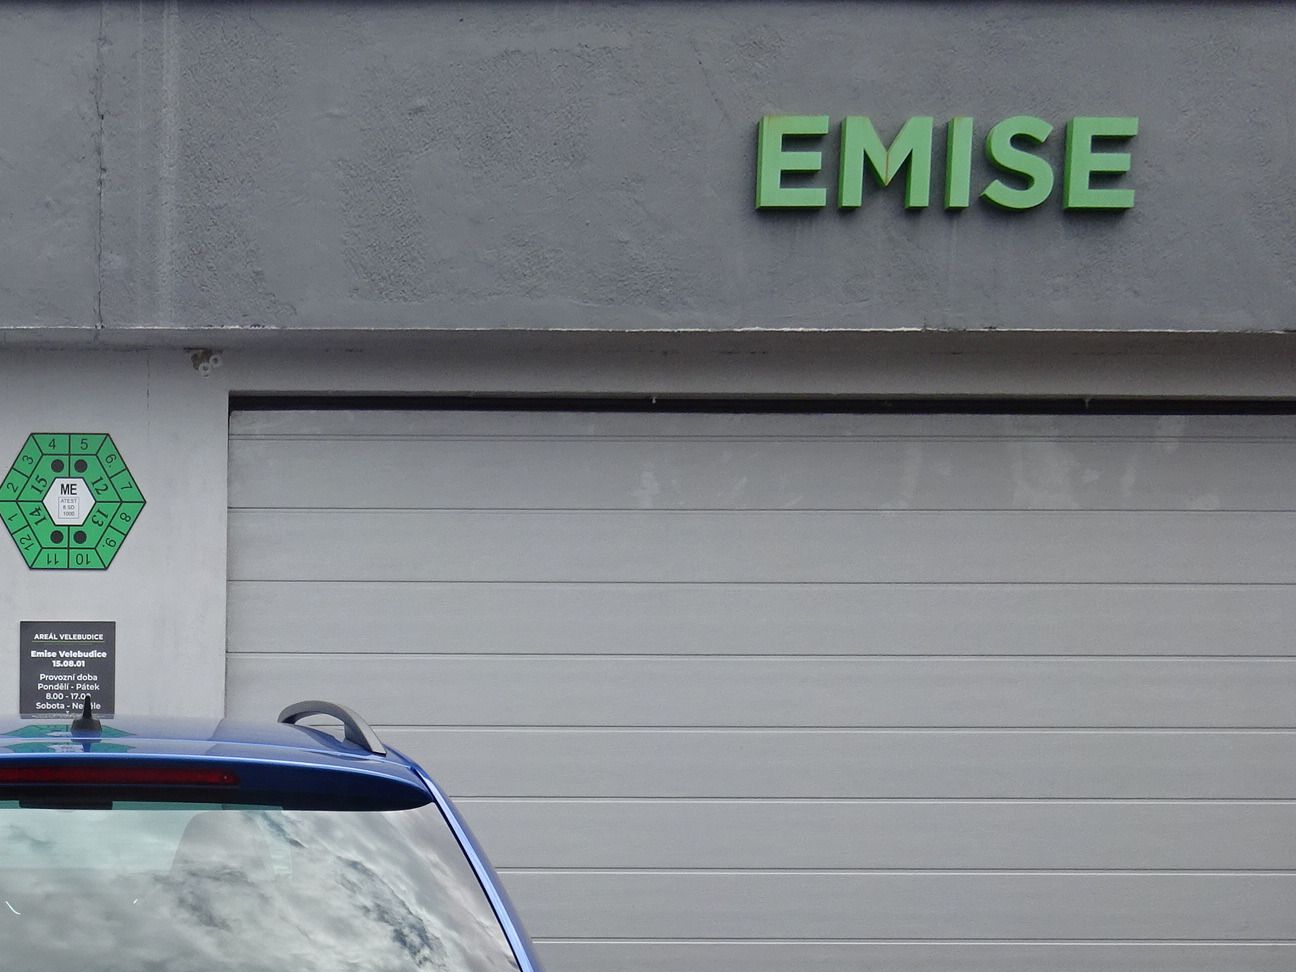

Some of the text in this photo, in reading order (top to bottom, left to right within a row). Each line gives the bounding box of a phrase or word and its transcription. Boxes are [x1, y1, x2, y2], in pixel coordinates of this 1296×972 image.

[756, 116, 1139, 211] EMISE
[49, 439, 56, 449] 4
[81, 439, 88, 449] 5
[7, 483, 19, 492] 2
[31, 475, 48, 493] 15
[61, 484, 77, 495] ME
[92, 476, 109, 495] 12
[29, 507, 47, 525] 14
[92, 509, 108, 526] 13
[120, 513, 131, 522] 8
[20, 534, 34, 551] 12
[47, 554, 59, 564] 11
[76, 554, 91, 565] 10
[31, 650, 107, 658] Emise Velebudice
[38, 683, 69, 691] Pondělí
